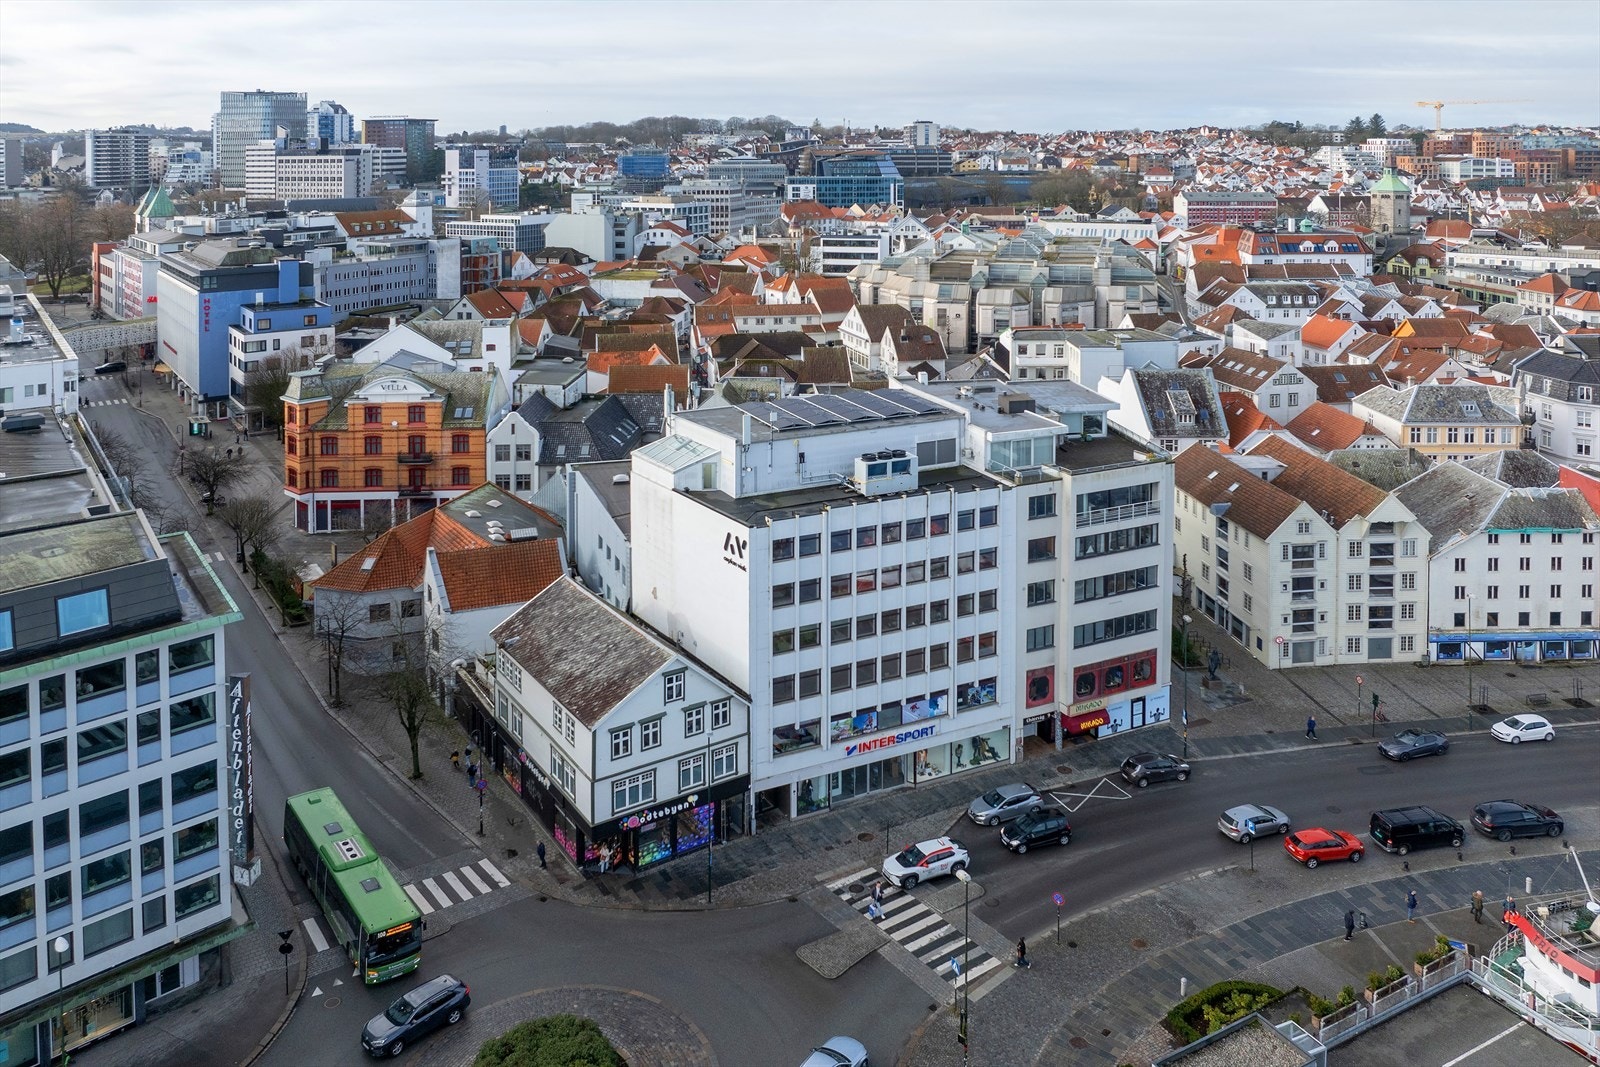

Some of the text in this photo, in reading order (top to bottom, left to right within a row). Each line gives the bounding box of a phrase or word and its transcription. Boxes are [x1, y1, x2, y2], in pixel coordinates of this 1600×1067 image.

[203, 298, 211, 332] HOTEL
[1076, 700, 1102, 713] MIKADO
[1080, 718, 1104, 730] MIKADO
[858, 725, 936, 753] INTERSPORT
[229, 680, 245, 844] Aftenbladet
[1533, 934, 1559, 959] TRIO
